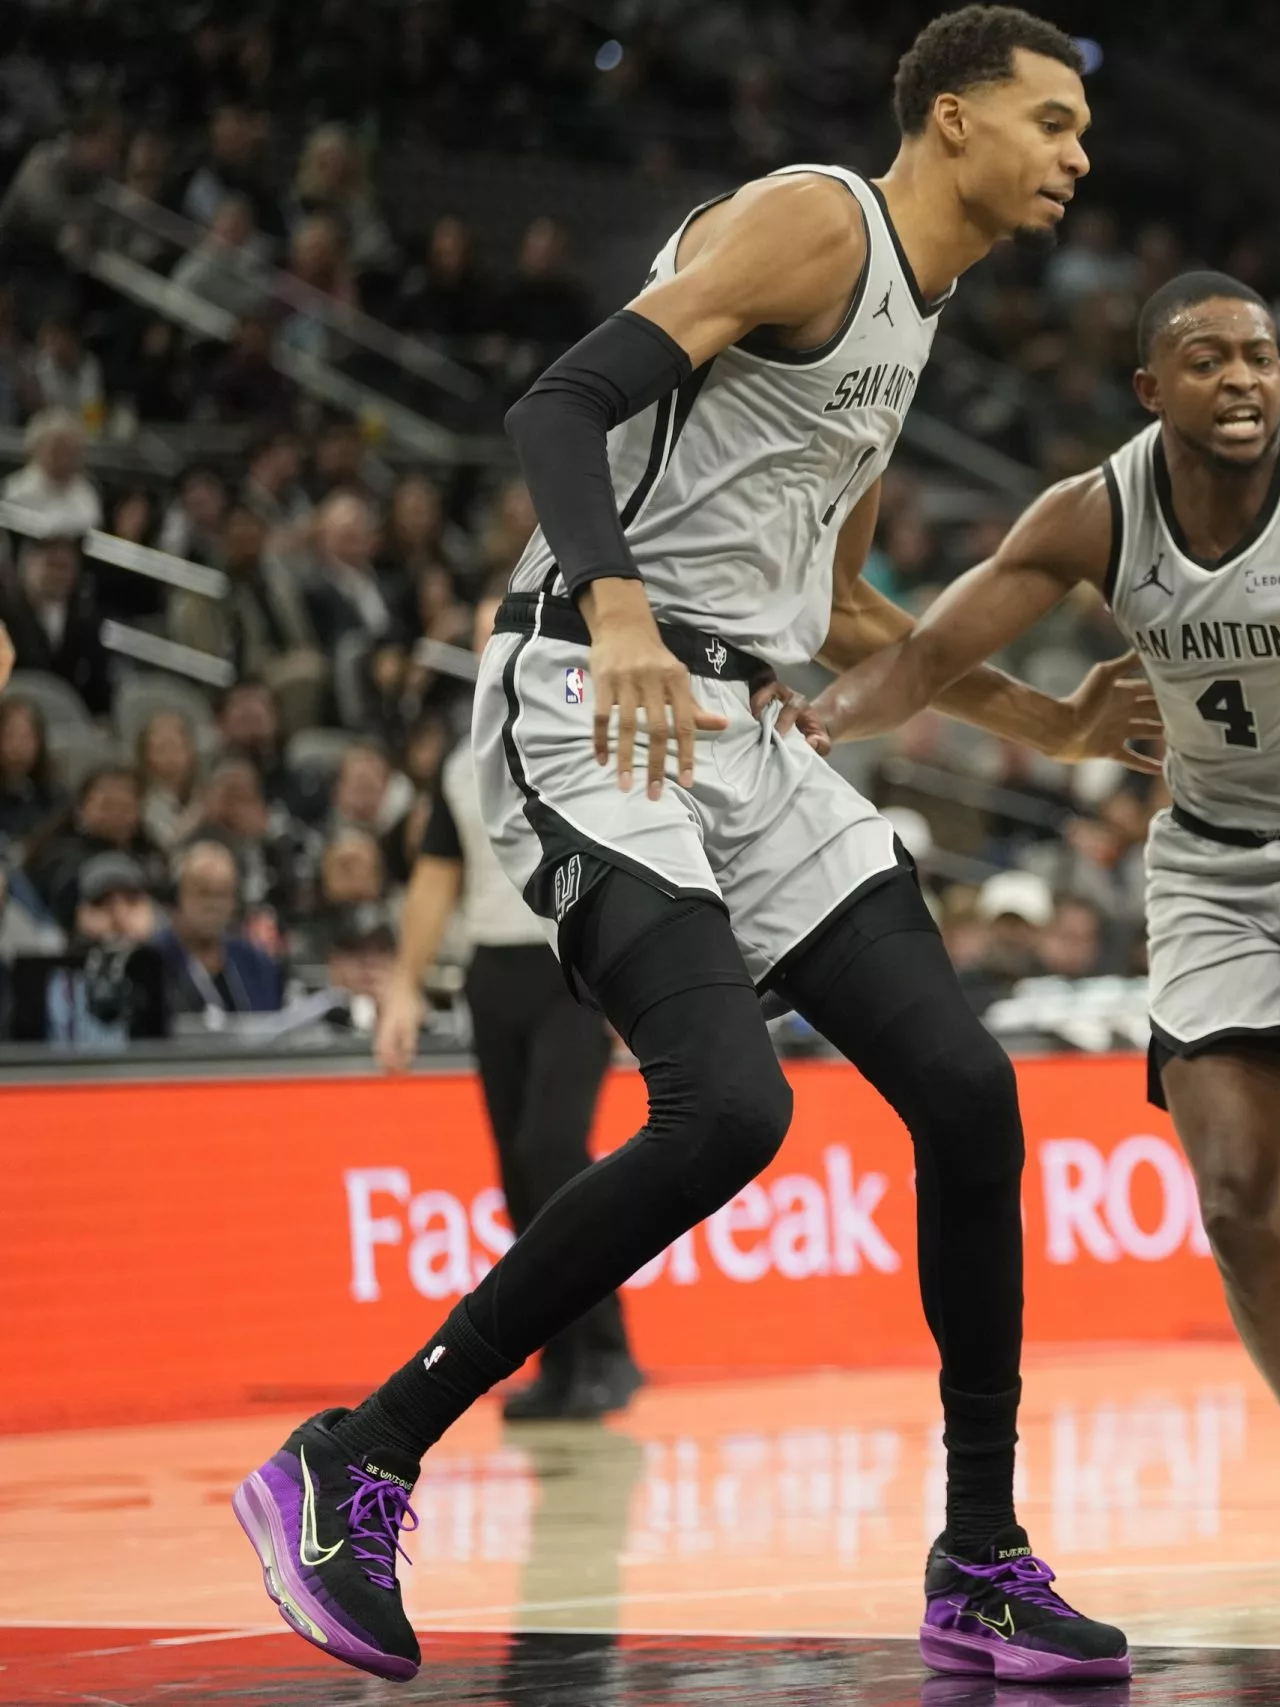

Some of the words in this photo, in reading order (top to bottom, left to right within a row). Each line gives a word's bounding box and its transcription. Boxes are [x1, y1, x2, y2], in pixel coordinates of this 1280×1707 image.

[823, 363, 889, 413] SAN
[1134, 627, 1172, 661] AN
[1195, 679, 1260, 750] 4
[342, 1167, 517, 1302] Fas
